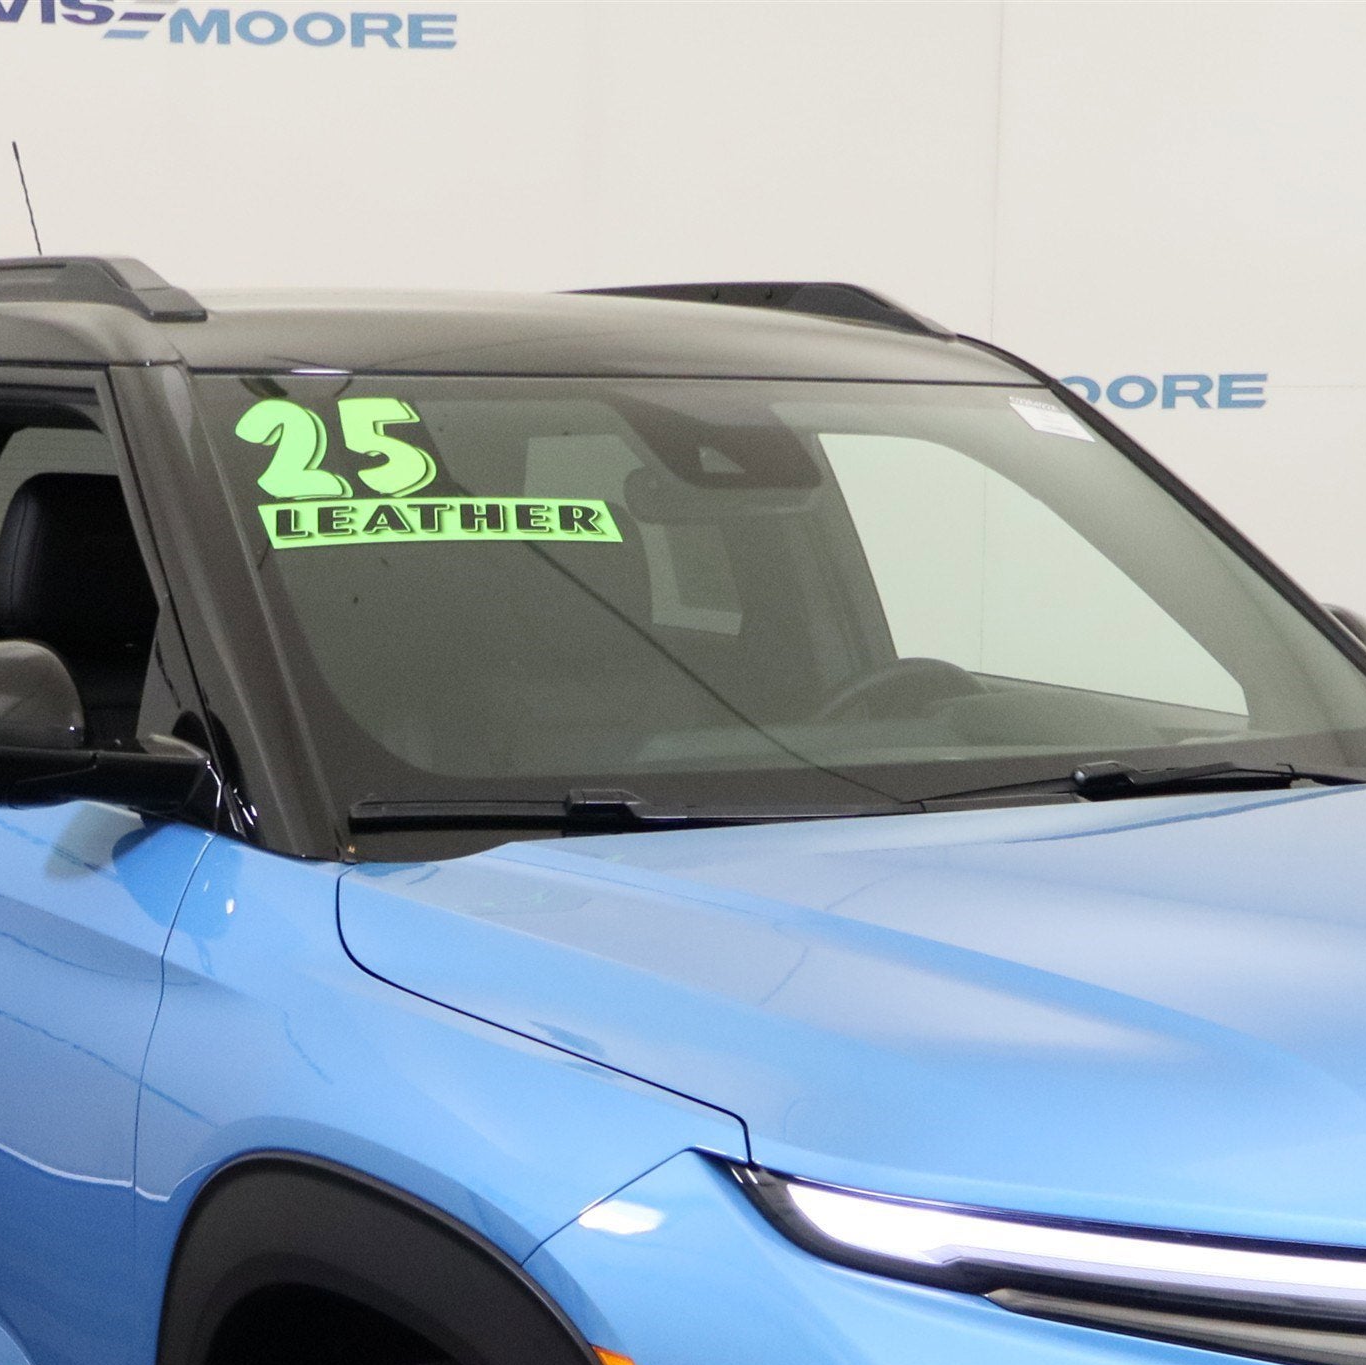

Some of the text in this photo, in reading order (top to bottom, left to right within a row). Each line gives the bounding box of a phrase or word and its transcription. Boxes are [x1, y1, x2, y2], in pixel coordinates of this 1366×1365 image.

[169, 8, 458, 50] MOORE
[1059, 373, 1269, 410] OORE
[235, 397, 437, 499] 25
[275, 502, 603, 540] LEATHER
